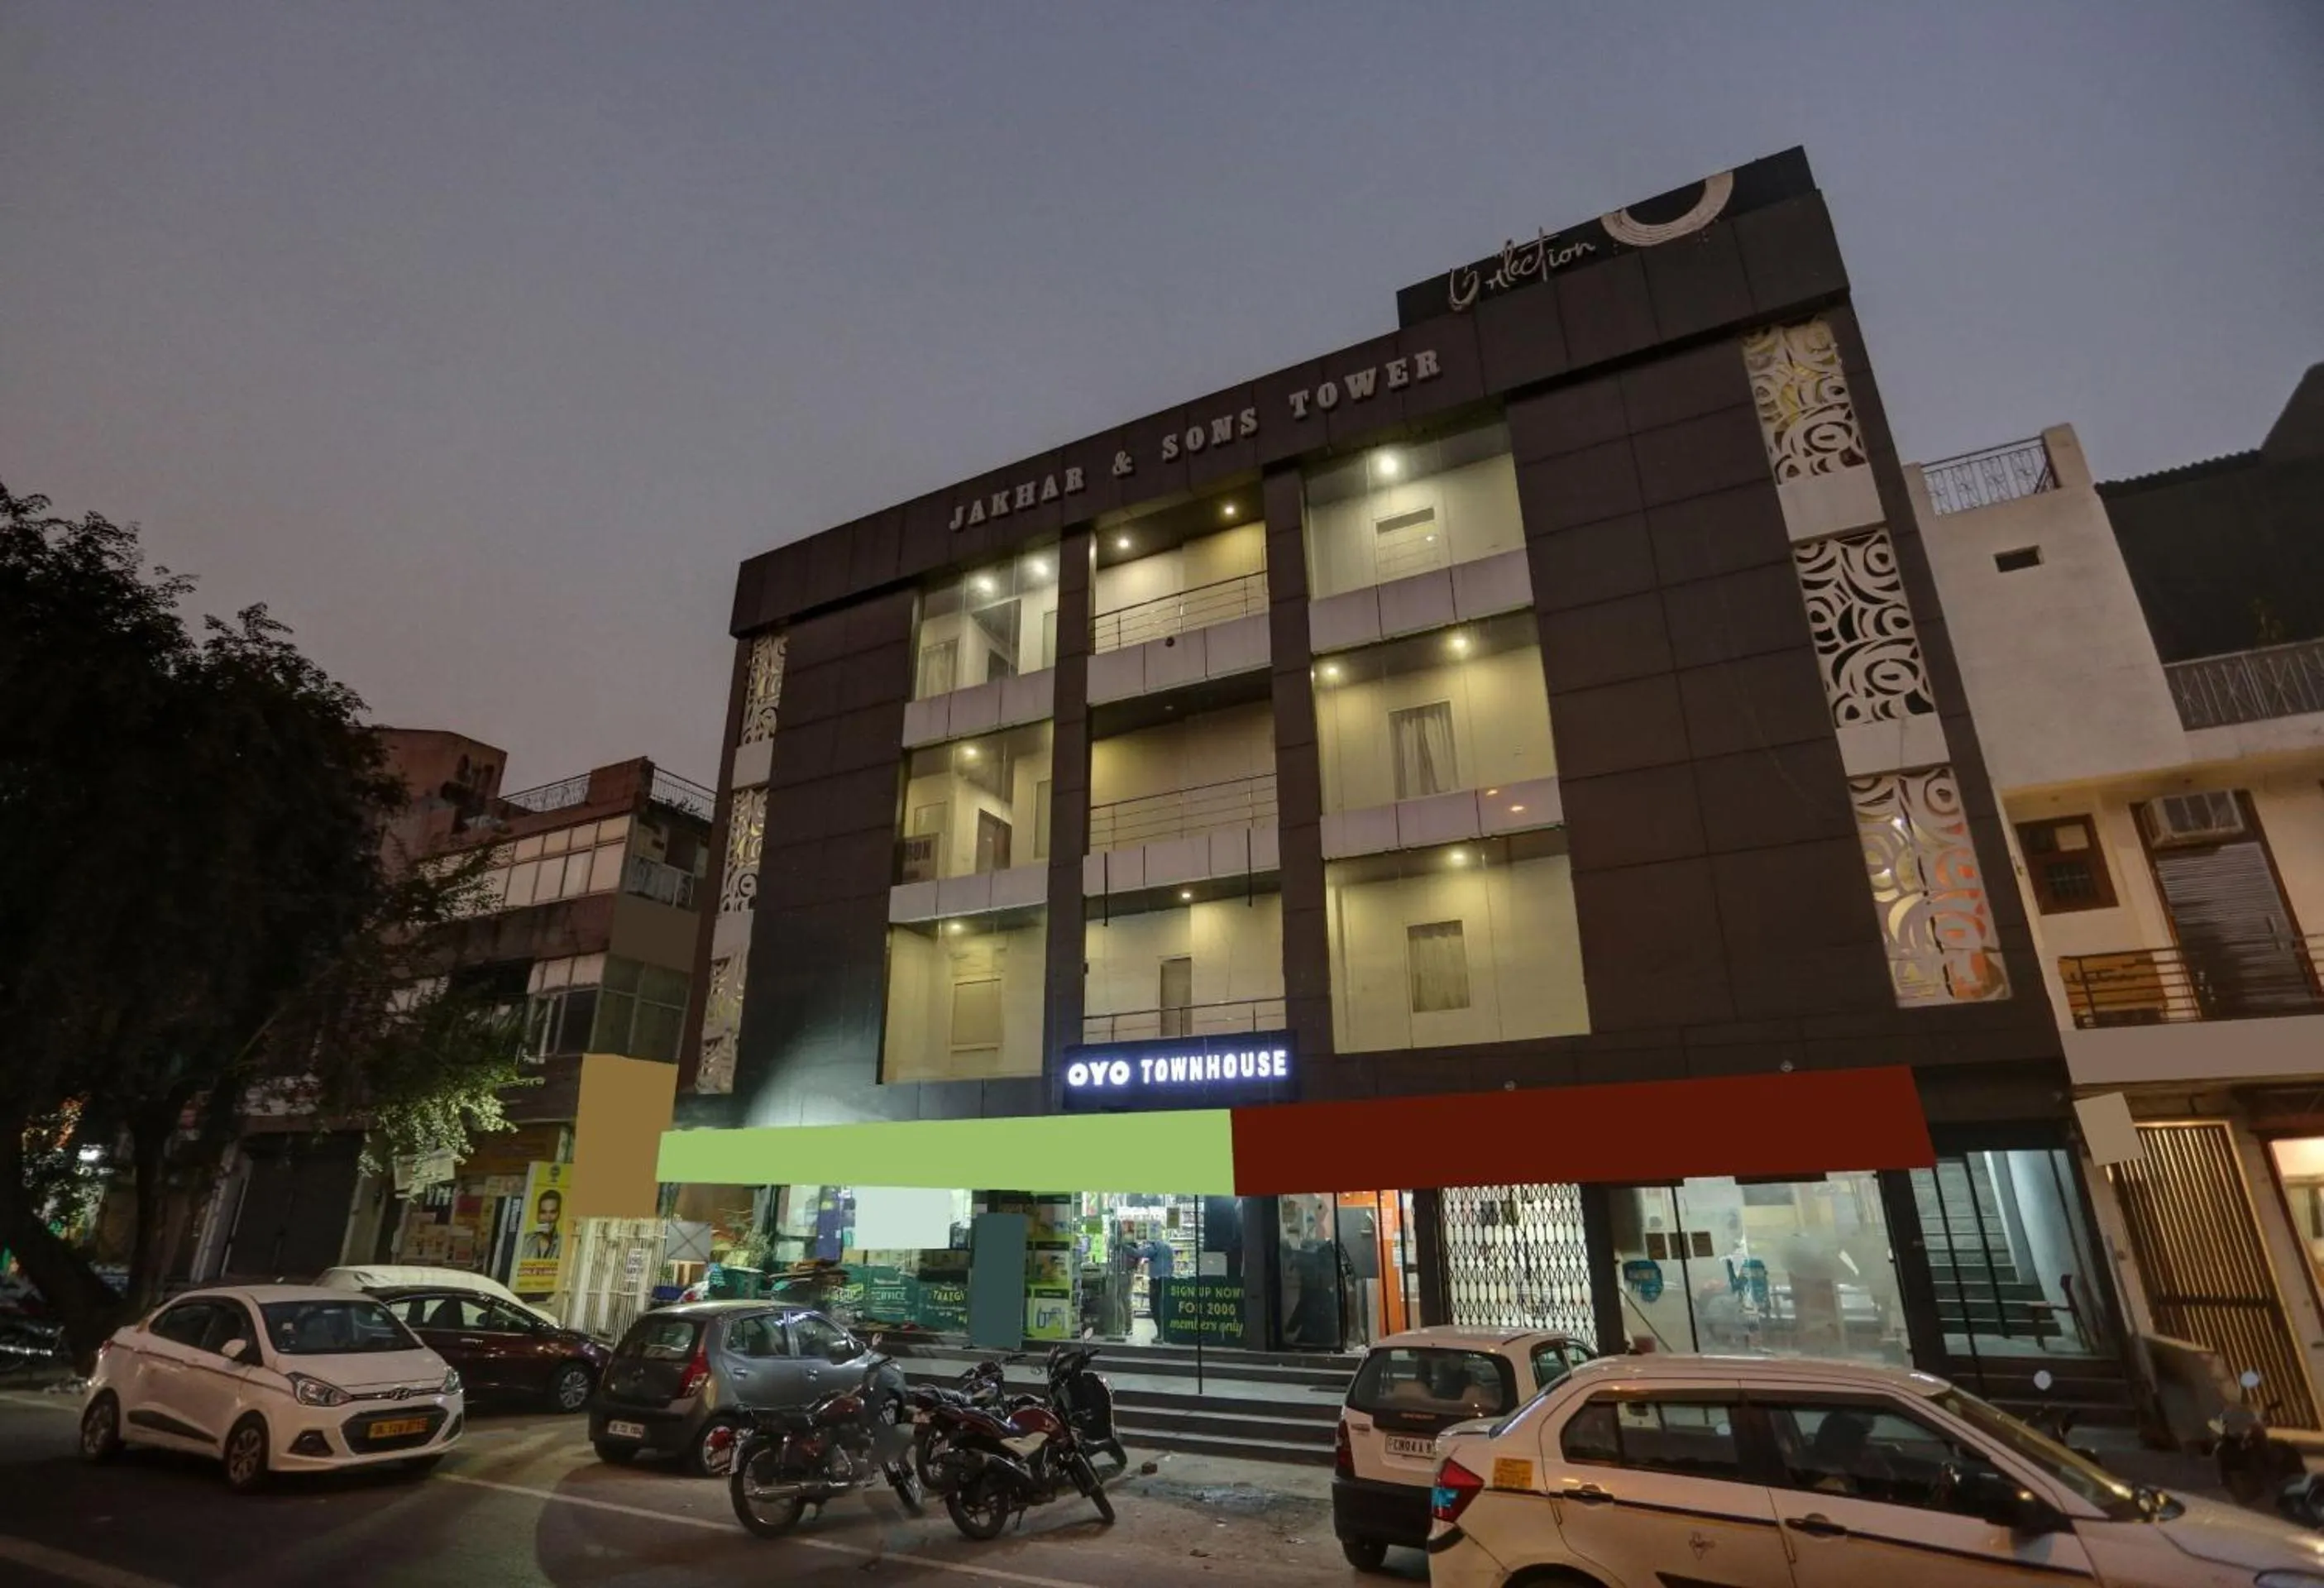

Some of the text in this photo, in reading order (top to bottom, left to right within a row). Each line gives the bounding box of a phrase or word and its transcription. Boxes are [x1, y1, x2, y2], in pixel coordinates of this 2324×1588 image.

[949, 348, 1442, 531] JAKHAR & SONS TOWER
[1067, 1049, 1289, 1087] OYO TOWNHOUSE
[1170, 1284, 1196, 1297] SIGN
[1198, 1286, 1212, 1299] UP
[1207, 1302, 1236, 1316] 2000
